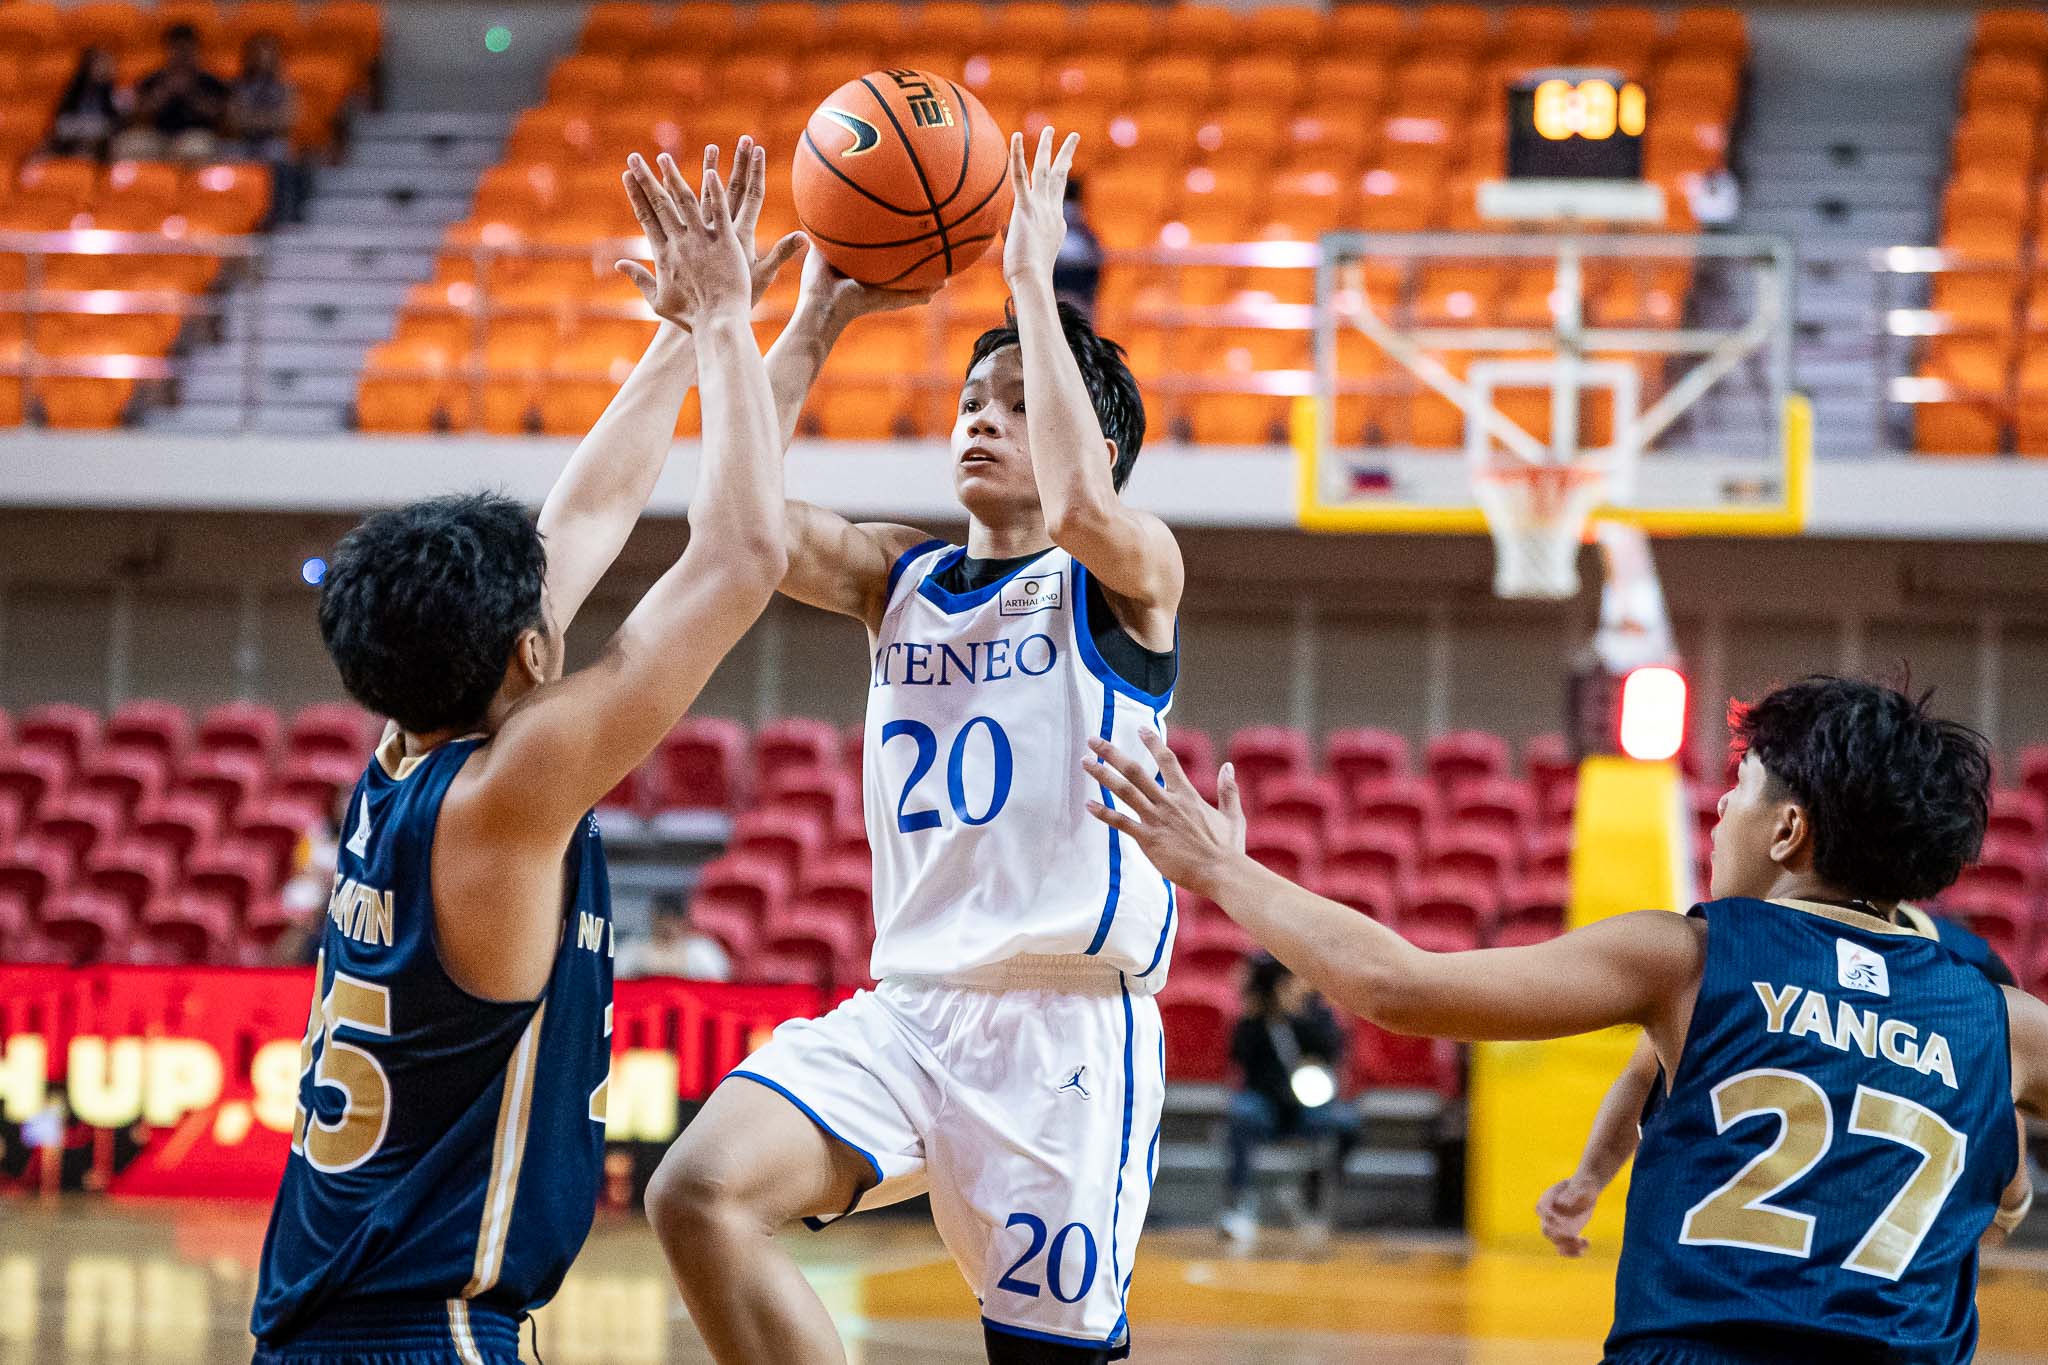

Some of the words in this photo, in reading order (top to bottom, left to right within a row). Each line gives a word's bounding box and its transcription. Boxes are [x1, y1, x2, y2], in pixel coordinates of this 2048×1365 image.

[881, 715, 1014, 834] 20
[1752, 981, 1960, 1090] YANGA
[1678, 1067, 1968, 1282] 27
[997, 1212, 1098, 1304] 20
